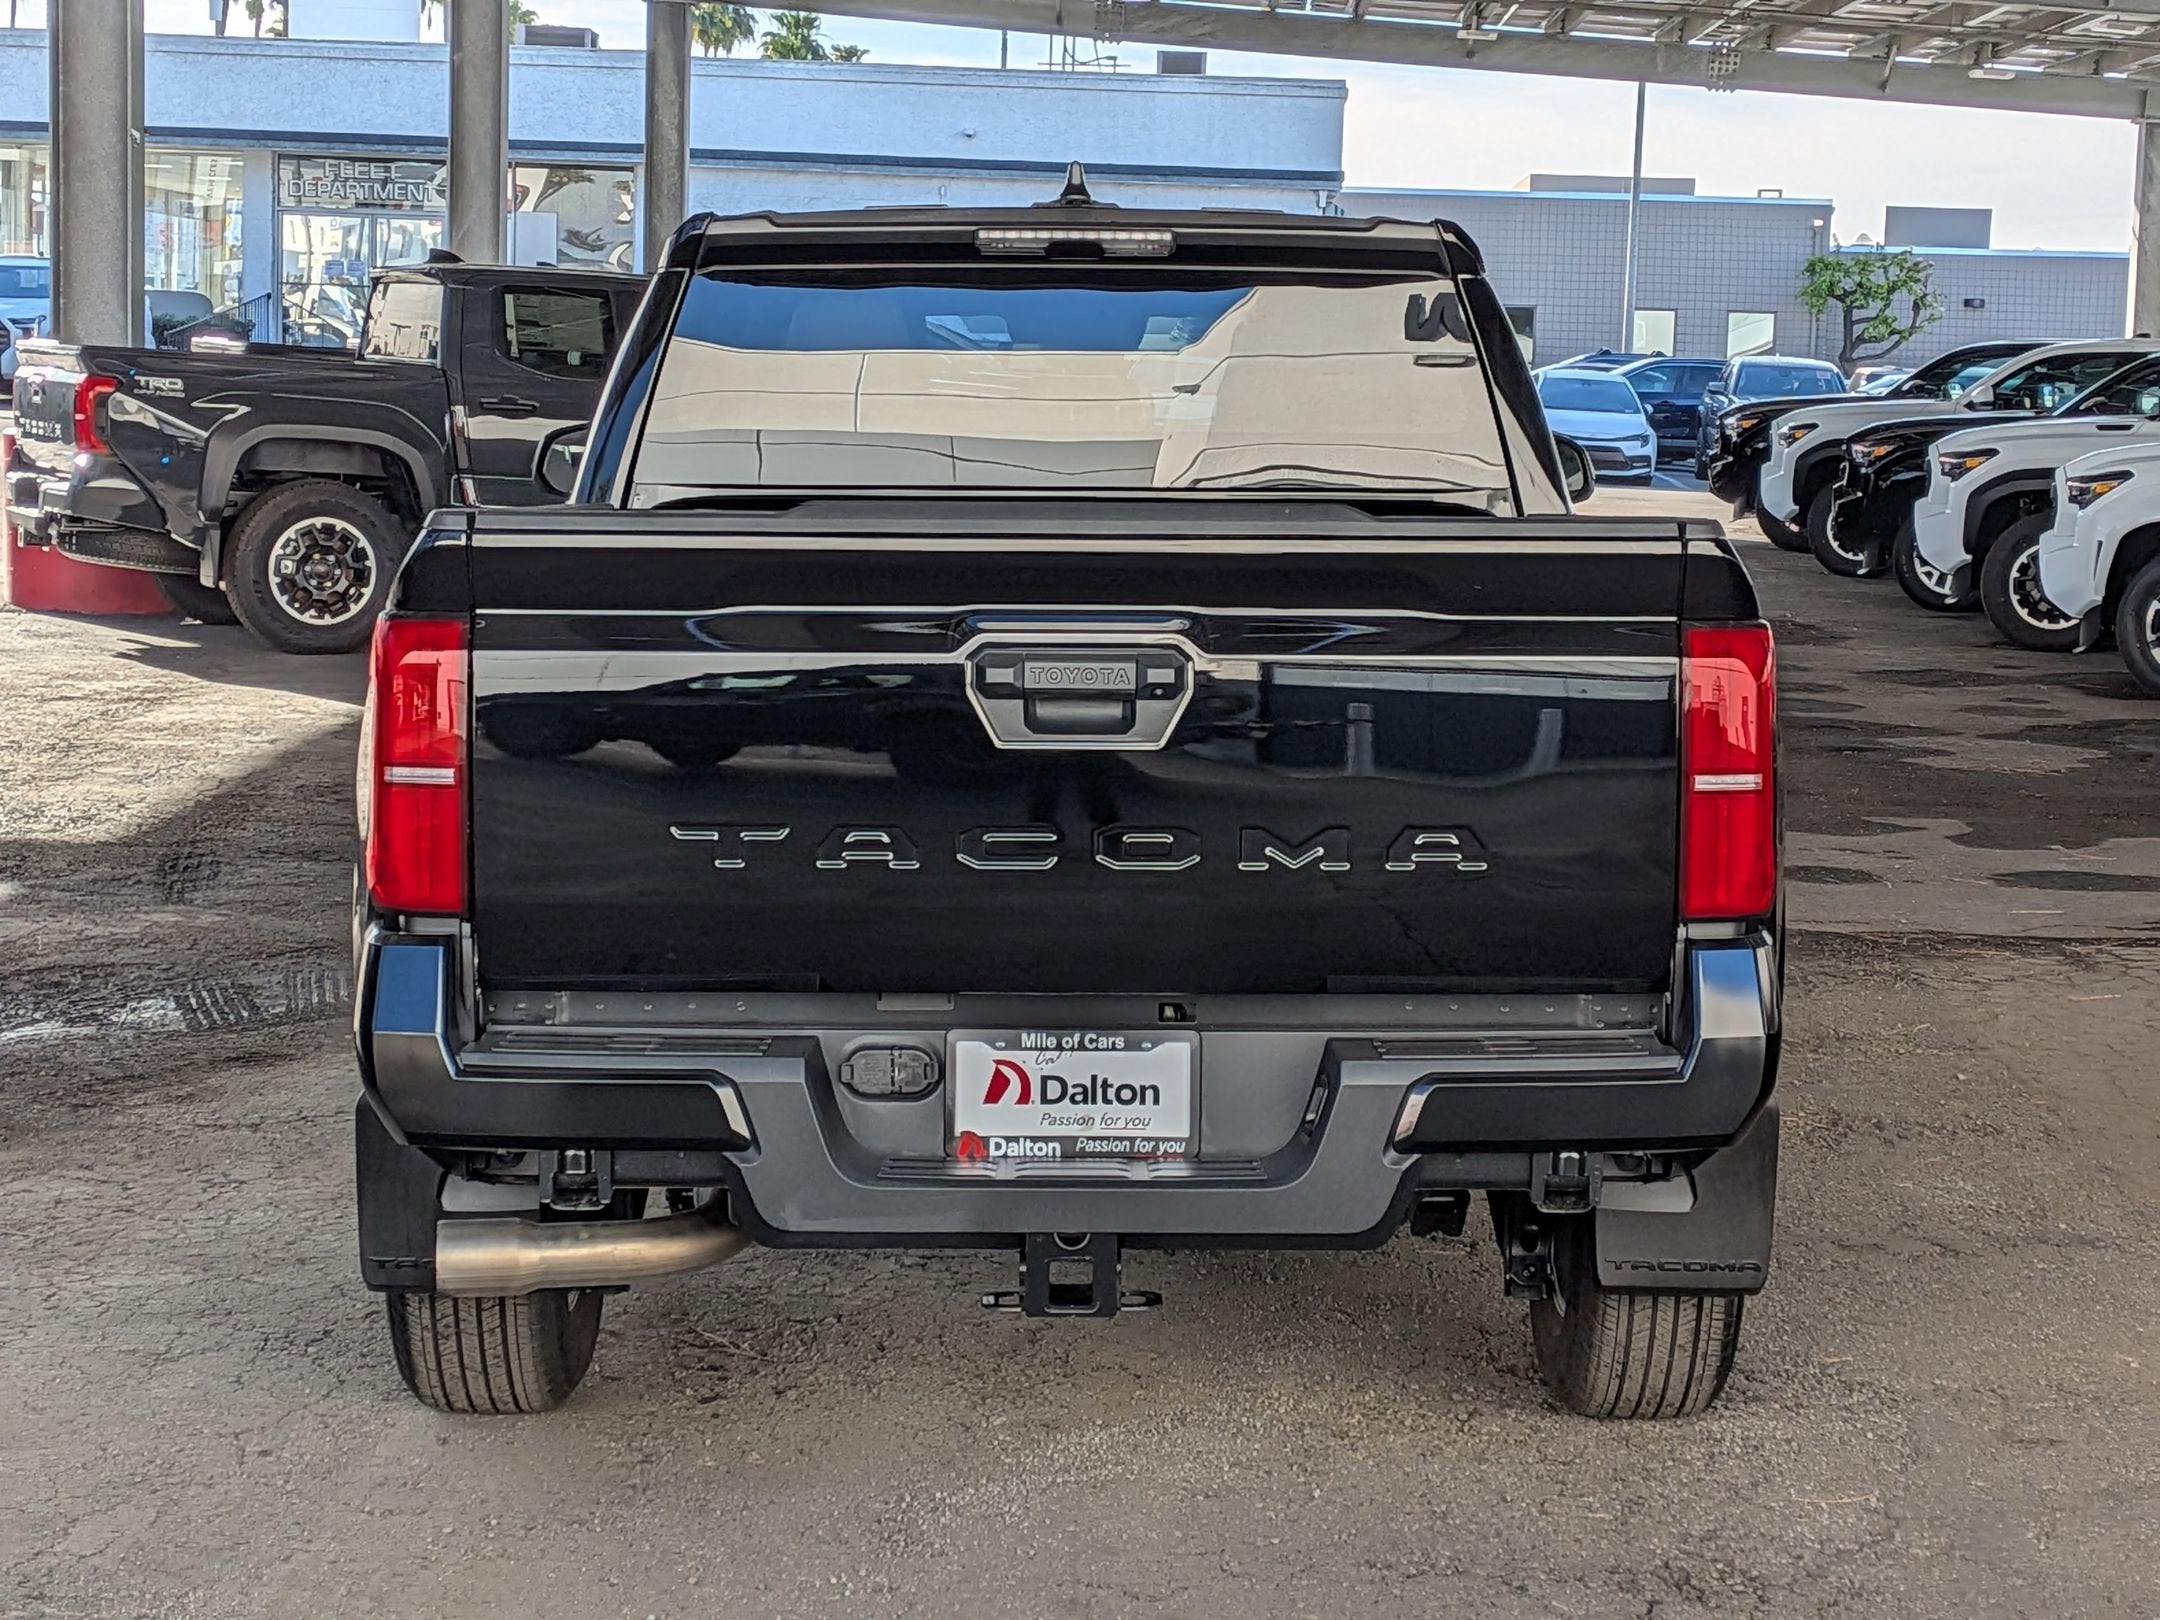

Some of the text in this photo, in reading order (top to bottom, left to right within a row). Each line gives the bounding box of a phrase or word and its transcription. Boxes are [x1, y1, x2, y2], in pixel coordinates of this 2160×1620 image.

[324, 161, 402, 180] FLEET
[288, 179, 435, 203] DEPARTMENT
[134, 375, 184, 391] TRD
[1029, 666, 1131, 686] TOYOTA
[668, 824, 1489, 872] TACOMA
[1021, 1033, 1125, 1049] Mile of Cars
[1039, 1074, 1161, 1106] Dalton
[1039, 1112, 1152, 1129] Passion for you
[988, 1137, 1187, 1158] Dalton Passion for you
[1604, 1257, 1763, 1273] TACOMA
